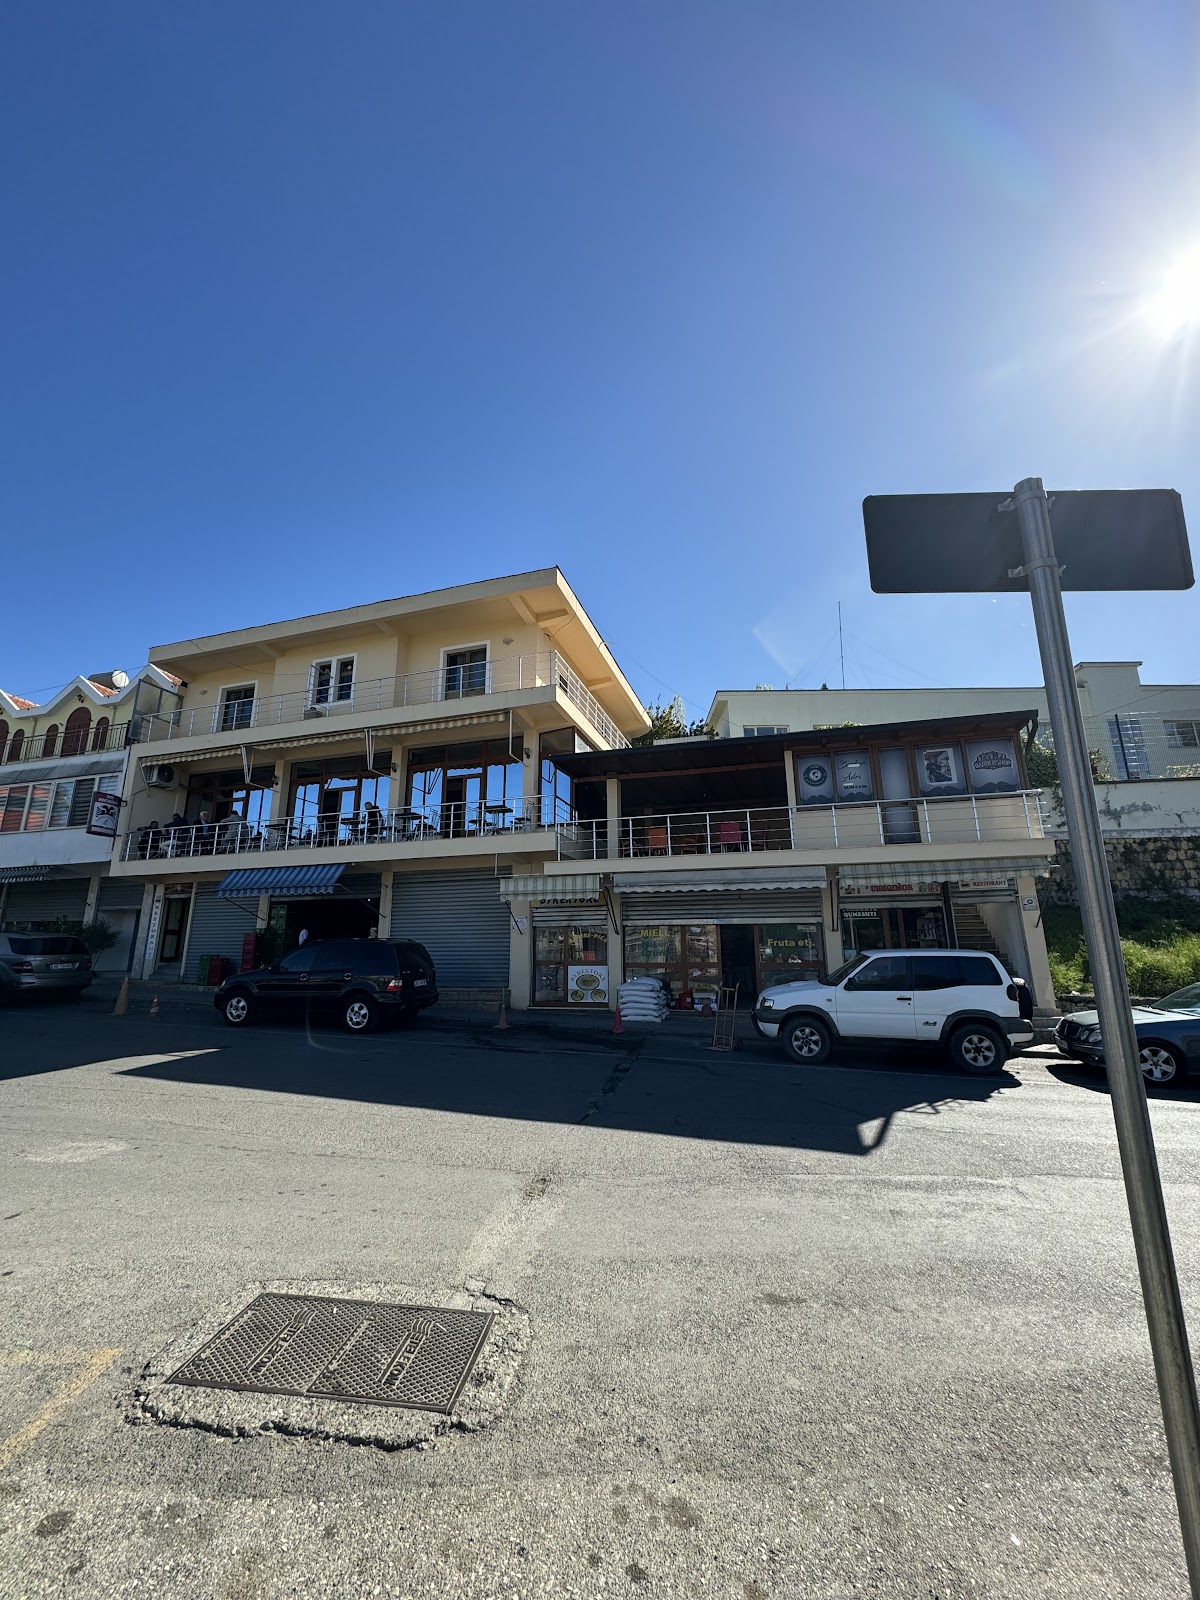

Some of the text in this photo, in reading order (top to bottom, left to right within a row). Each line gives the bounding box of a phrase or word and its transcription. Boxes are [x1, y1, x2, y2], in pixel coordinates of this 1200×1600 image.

[147, 905, 160, 958] RESTORANT
[767, 938, 815, 949] Fruta etj.
[570, 968, 606, 982] BYREKTORE
